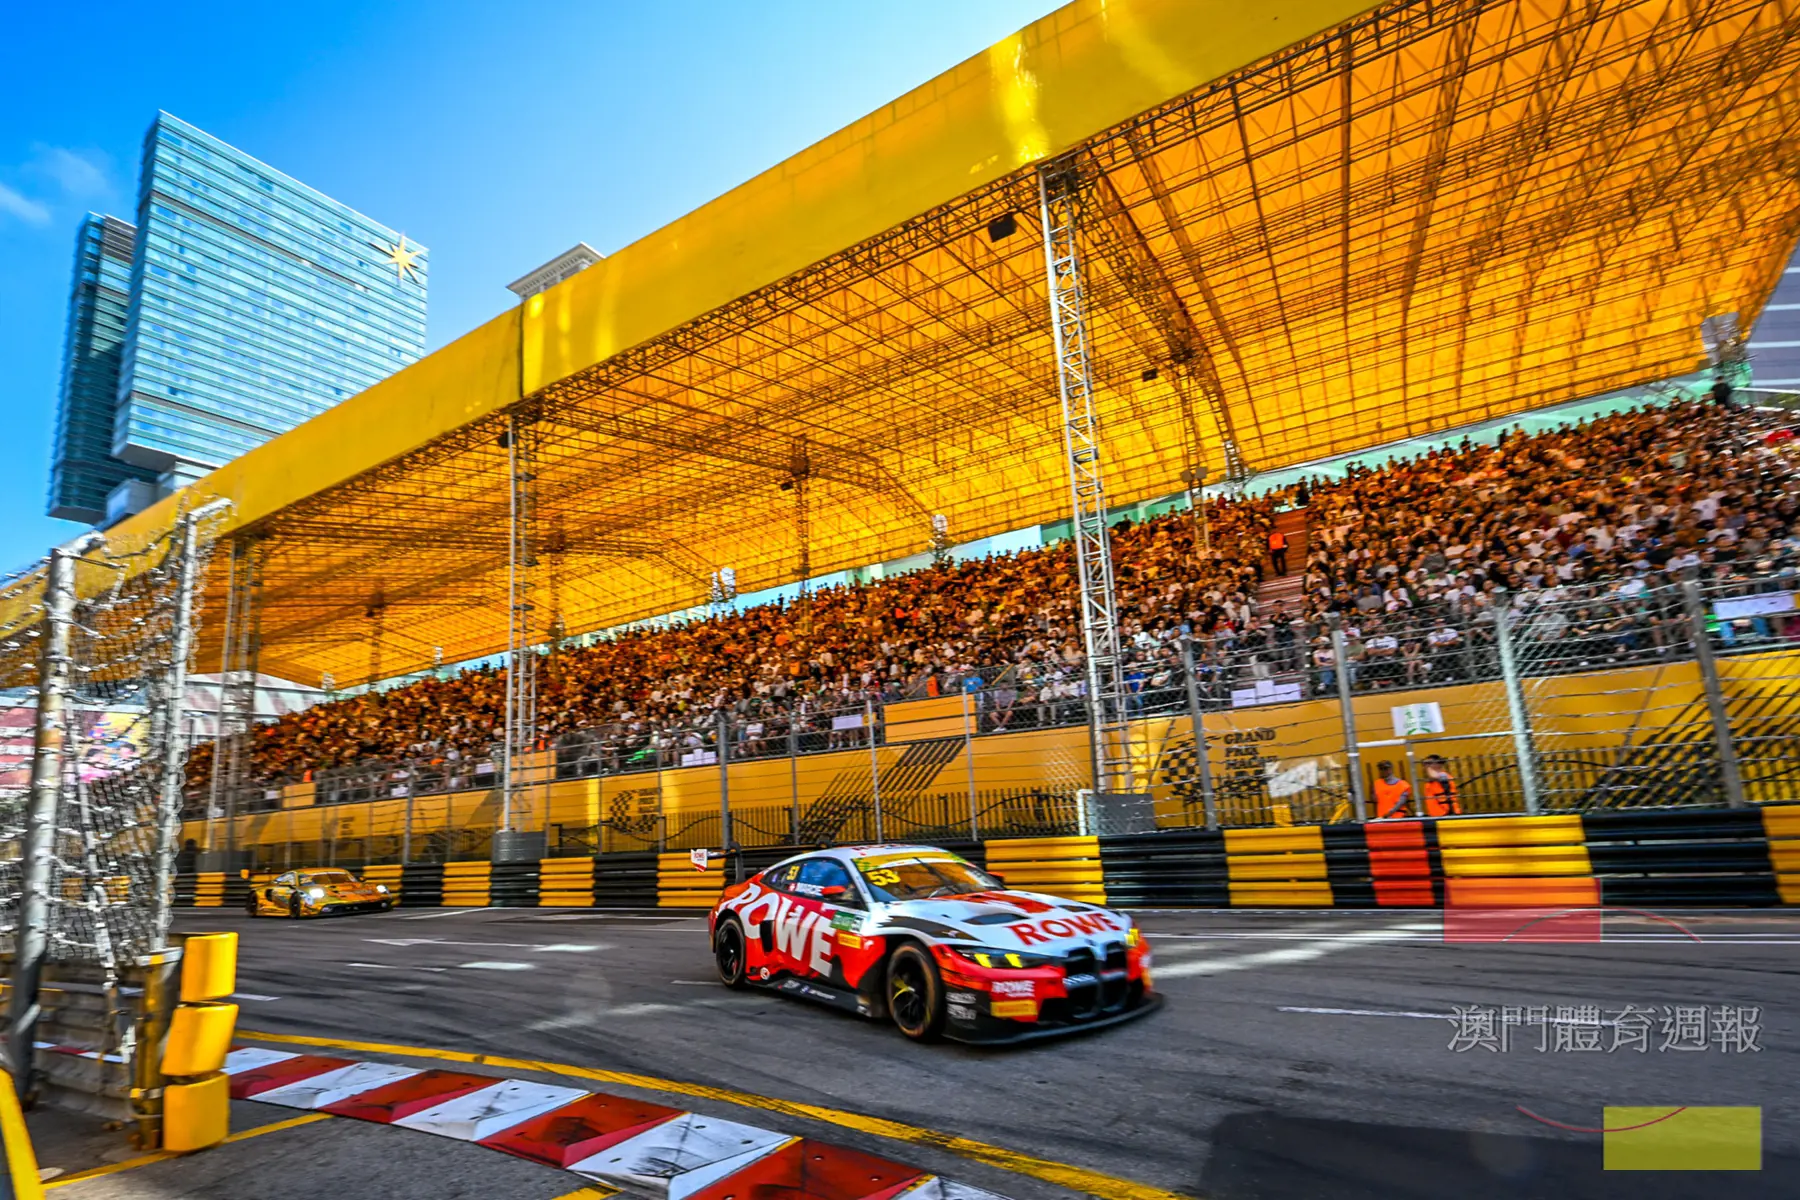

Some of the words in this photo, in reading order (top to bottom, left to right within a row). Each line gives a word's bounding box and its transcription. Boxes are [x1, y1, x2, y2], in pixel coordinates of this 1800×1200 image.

[1224, 730, 1275, 744] GRAND
[867, 869, 901, 886] 53
[717, 883, 836, 978] ROWE
[1007, 913, 1122, 946] ROWE
[991, 980, 1035, 993] ROWE
